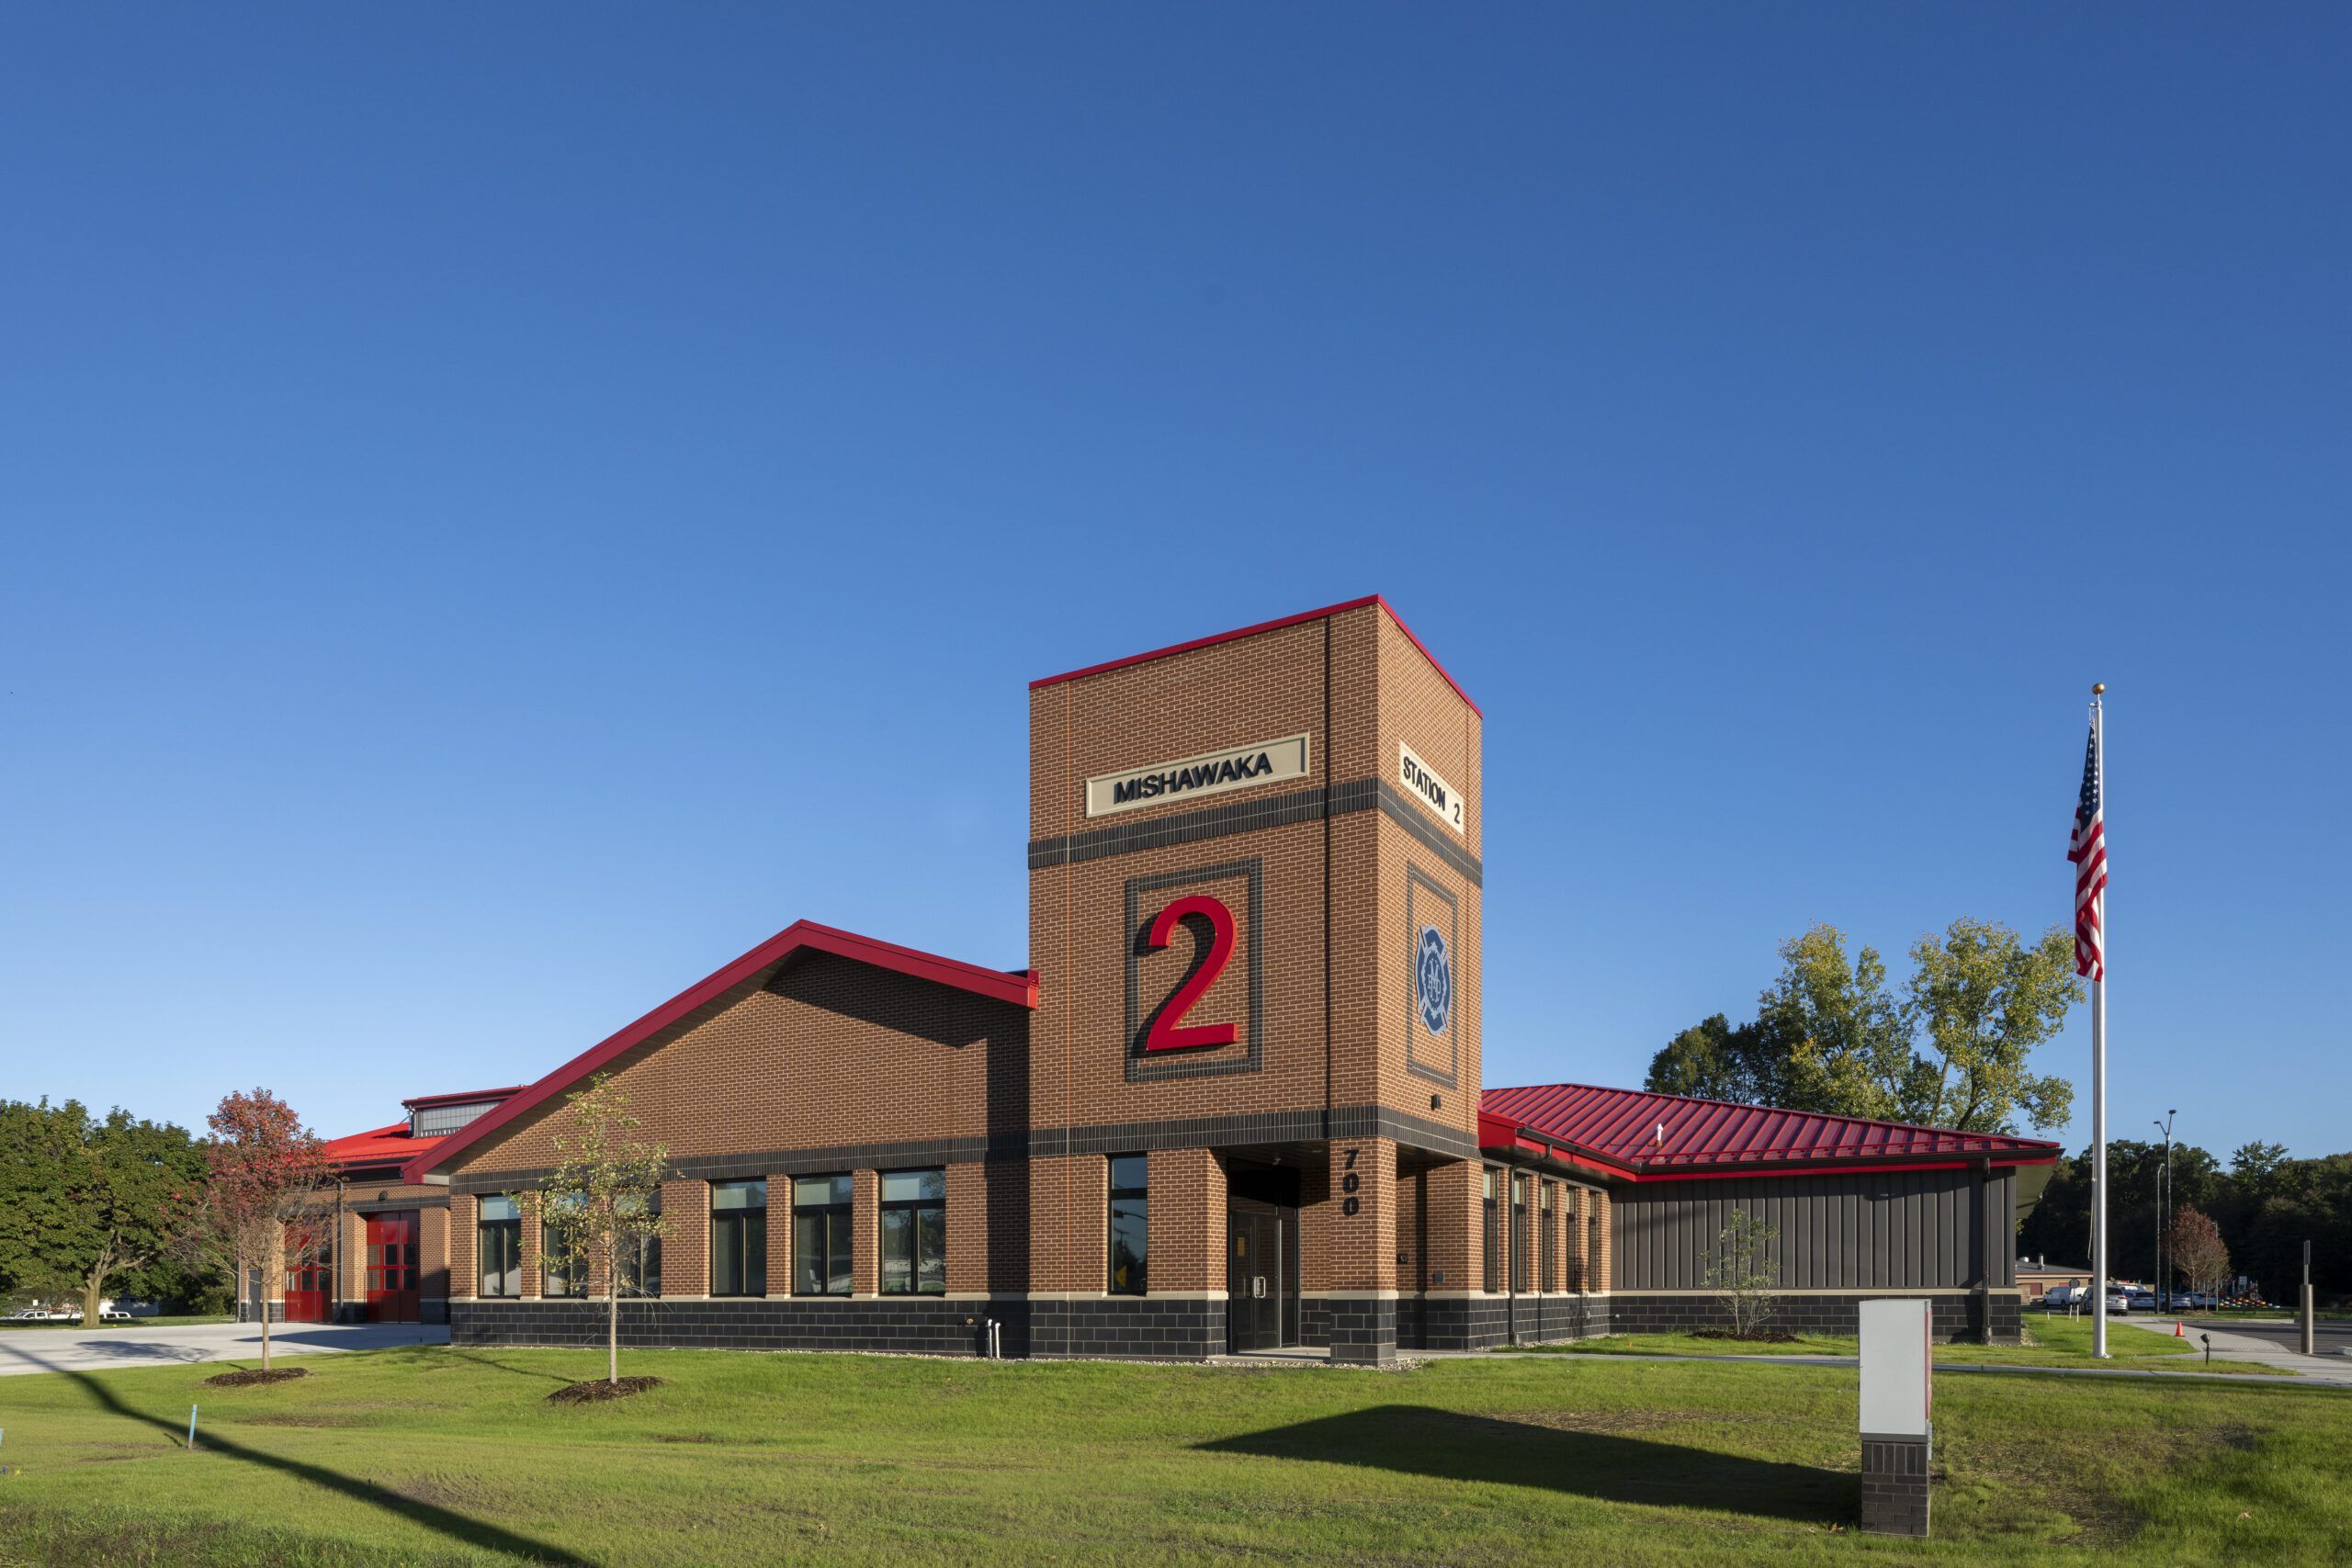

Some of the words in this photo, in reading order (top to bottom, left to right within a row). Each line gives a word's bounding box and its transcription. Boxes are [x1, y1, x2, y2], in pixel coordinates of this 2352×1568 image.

[1114, 752, 1273, 805] MISHAWAKA
[1403, 756, 1446, 811] STATION
[1453, 803, 1461, 825] 2
[1147, 895, 1238, 1051] 2
[1342, 1149, 1360, 1217] 700
